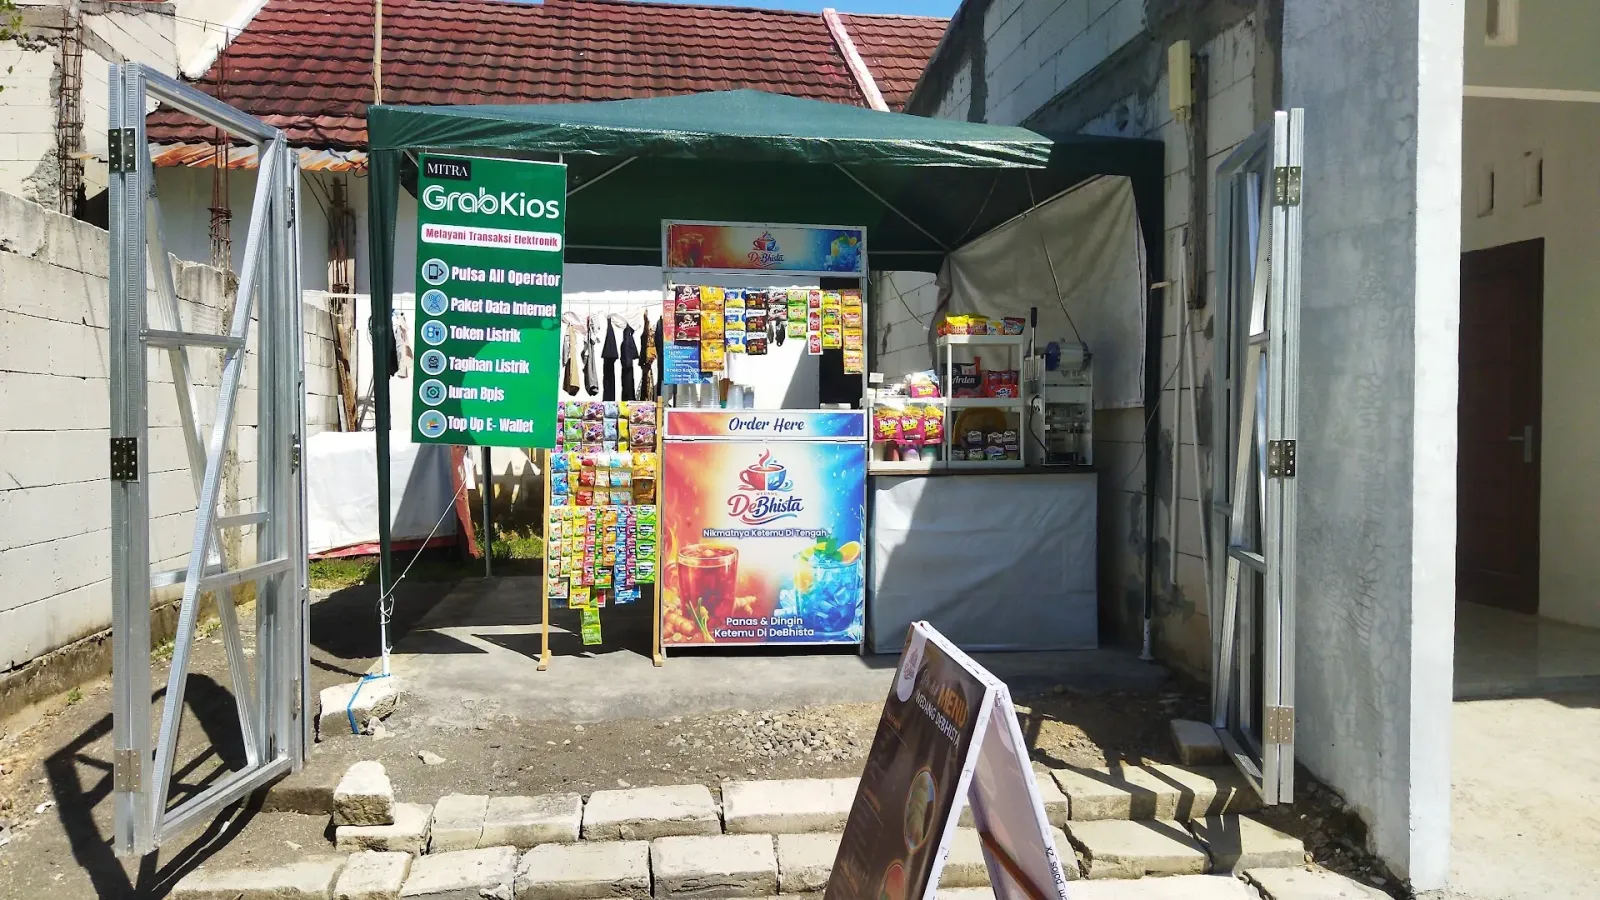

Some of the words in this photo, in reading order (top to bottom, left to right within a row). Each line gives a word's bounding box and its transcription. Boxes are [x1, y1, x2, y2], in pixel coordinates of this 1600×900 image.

[427, 163, 468, 177] MITRA
[422, 184, 560, 219] GrabKios
[426, 228, 466, 241] Melayani
[469, 231, 511, 244] Transaksi
[514, 234, 558, 247] Elektronik
[451, 266, 486, 282] Pulsa
[489, 269, 505, 283] All
[508, 270, 561, 287] Operator
[450, 298, 483, 313] Paket
[485, 300, 511, 315] Data
[513, 301, 557, 317] Internet
[450, 326, 484, 341] Token
[486, 327, 521, 343] Listrik
[449, 357, 493, 373] Tagihan
[495, 359, 530, 374] Listrik
[448, 385, 478, 400] Iuran
[480, 387, 505, 403] Bpjs
[448, 416, 468, 432] Top
[470, 417, 484, 432] Up
[499, 418, 534, 433] Wallet
[728, 416, 770, 431] Order
[773, 417, 805, 432] Here
[727, 494, 804, 518] DeBhista
[703, 529, 750, 538] Nikmatnya
[751, 529, 784, 537] Ketemu
[785, 529, 794, 537] Di
[796, 529, 827, 539] Tengah
[726, 617, 758, 626] Panas
[760, 617, 768, 626] &
[770, 616, 803, 627] Dingin
[714, 628, 755, 638] Ketemu
[757, 628, 767, 637] Di
[769, 628, 814, 637] DeBhista
[937, 686, 969, 728] MENU
